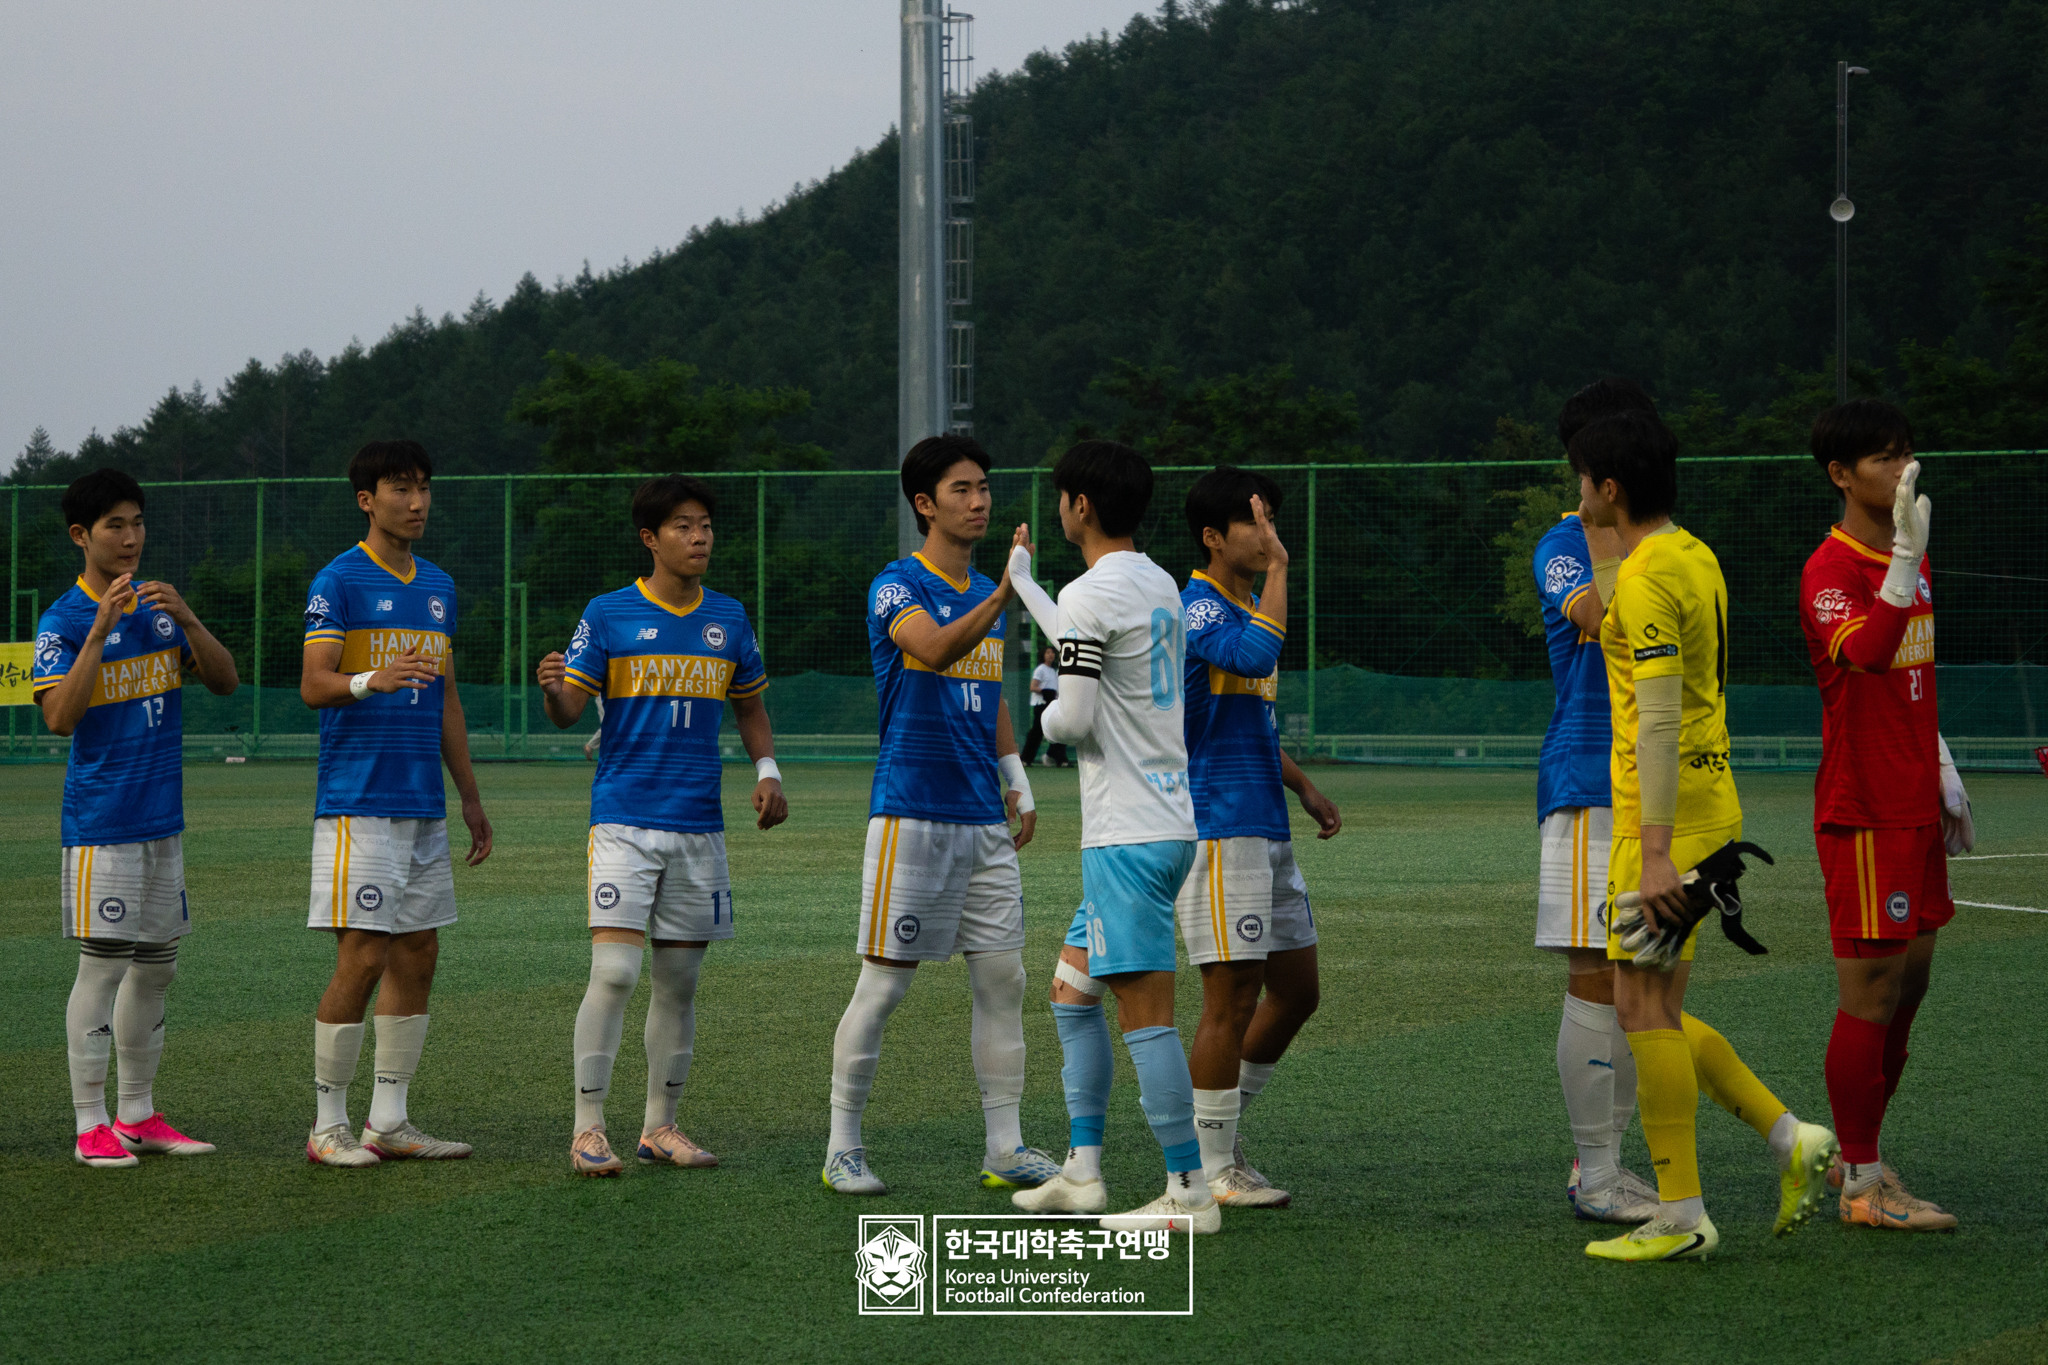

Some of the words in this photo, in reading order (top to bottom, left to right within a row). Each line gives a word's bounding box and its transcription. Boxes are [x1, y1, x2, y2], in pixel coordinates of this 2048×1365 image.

[370, 632, 446, 656] HANYAN
[1060, 642, 1076, 667] C
[102, 653, 179, 686] HANYANG
[630, 658, 727, 682] HANYANG
[1908, 668, 1923, 701] 21
[632, 678, 722, 696] UNIVERSITY
[961, 682, 982, 713] 16
[142, 696, 164, 728] 13
[670, 699, 692, 729] 11
[711, 890, 733, 925] 11
